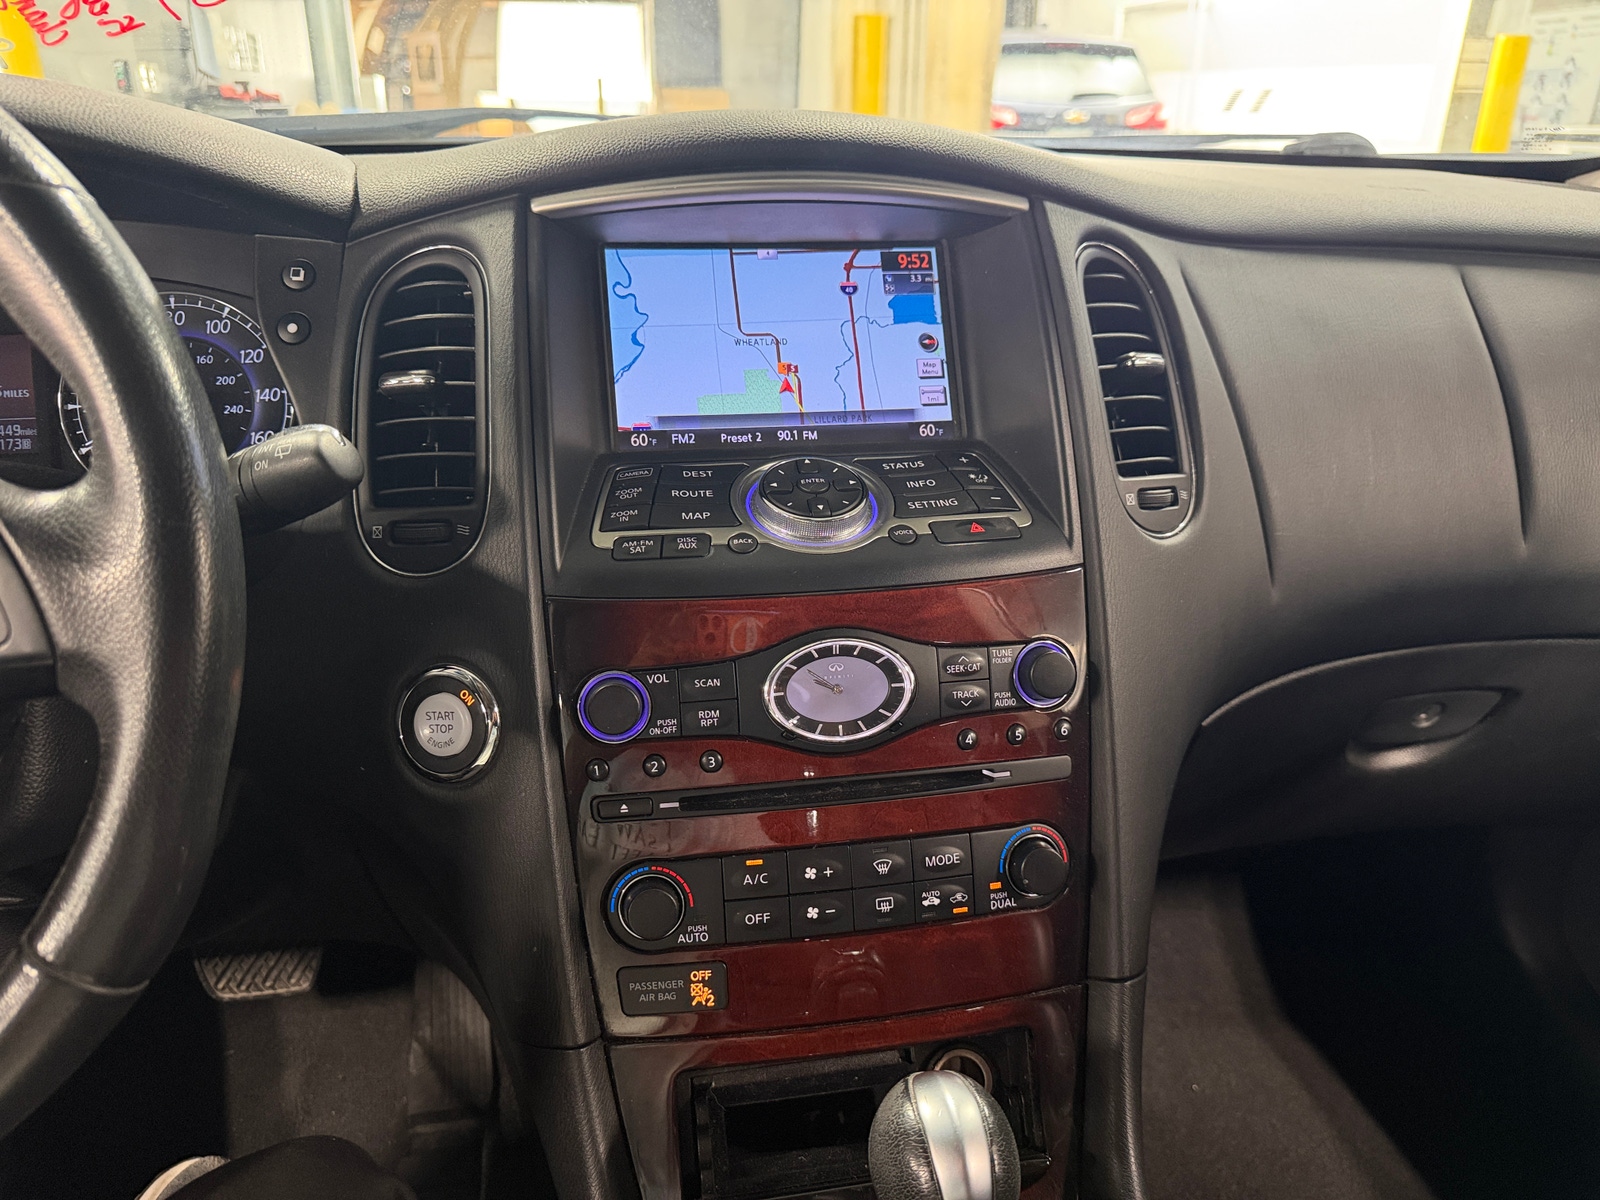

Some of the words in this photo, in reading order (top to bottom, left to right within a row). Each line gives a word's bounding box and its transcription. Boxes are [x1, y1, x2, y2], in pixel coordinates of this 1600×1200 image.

[897, 253, 930, 269] 9:52
[910, 274, 922, 283] 3.3
[206, 319, 231, 334] 100
[734, 338, 788, 346] WHEATLAND
[196, 355, 214, 364] 160
[240, 349, 264, 364] 120
[922, 361, 937, 369] Map
[215, 376, 236, 385] 200
[3, 389, 30, 398] MILES
[255, 387, 281, 402] 140
[223, 405, 244, 414] 240
[813, 414, 848, 424] LILLARD
[851, 414, 873, 423] PARK
[671, 433, 696, 445] FM2
[720, 433, 753, 443] Preset
[755, 432, 763, 442] 2
[777, 430, 799, 441] 90.1
[802, 430, 819, 441] FM
[254, 459, 269, 471] ON
[882, 460, 925, 470] STATUS
[619, 470, 649, 479] CAMERA
[682, 470, 713, 478] DEST
[800, 477, 826, 485] ENTER
[906, 479, 936, 489] INFO
[615, 487, 643, 496] ZOOM
[620, 492, 637, 500] OUT
[671, 489, 714, 498] ROUTE
[907, 498, 958, 509] SETTING
[610, 509, 638, 518] ZOOM
[681, 511, 711, 520] MAP
[893, 528, 915, 536] VOICE
[629, 546, 646, 554] SAT
[678, 541, 698, 550] AUX
[992, 649, 1013, 657] TUNE
[646, 673, 670, 684] VOL
[694, 678, 721, 688] SCAN
[460, 689, 476, 707] ON
[952, 689, 980, 698] TRACK
[994, 691, 1012, 699] PUSH
[994, 698, 1017, 707] AUDIO
[425, 711, 455, 721] START
[698, 709, 720, 719] RDM
[657, 718, 678, 727] PUSH
[700, 718, 719, 727] RPT
[428, 723, 454, 734] STOP
[1060, 726, 1068, 736] 6
[965, 735, 973, 745] 4
[1014, 730, 1022, 741] 5
[427, 736, 456, 749] ENGINE
[650, 761, 659, 773] 2
[707, 756, 716, 768] 3
[593, 765, 600, 776] 1
[925, 853, 961, 867] MODE
[743, 873, 769, 885] A/C
[921, 890, 941, 898] AUTO
[990, 891, 1008, 900] PUSH
[990, 897, 1017, 910] DUAL
[744, 913, 771, 925] OFF
[677, 932, 709, 943] AUTO
[690, 970, 712, 981] OFF
[629, 979, 684, 991] PASSENGER
[639, 992, 655, 1002] AIR
[657, 992, 677, 1001] BAG
